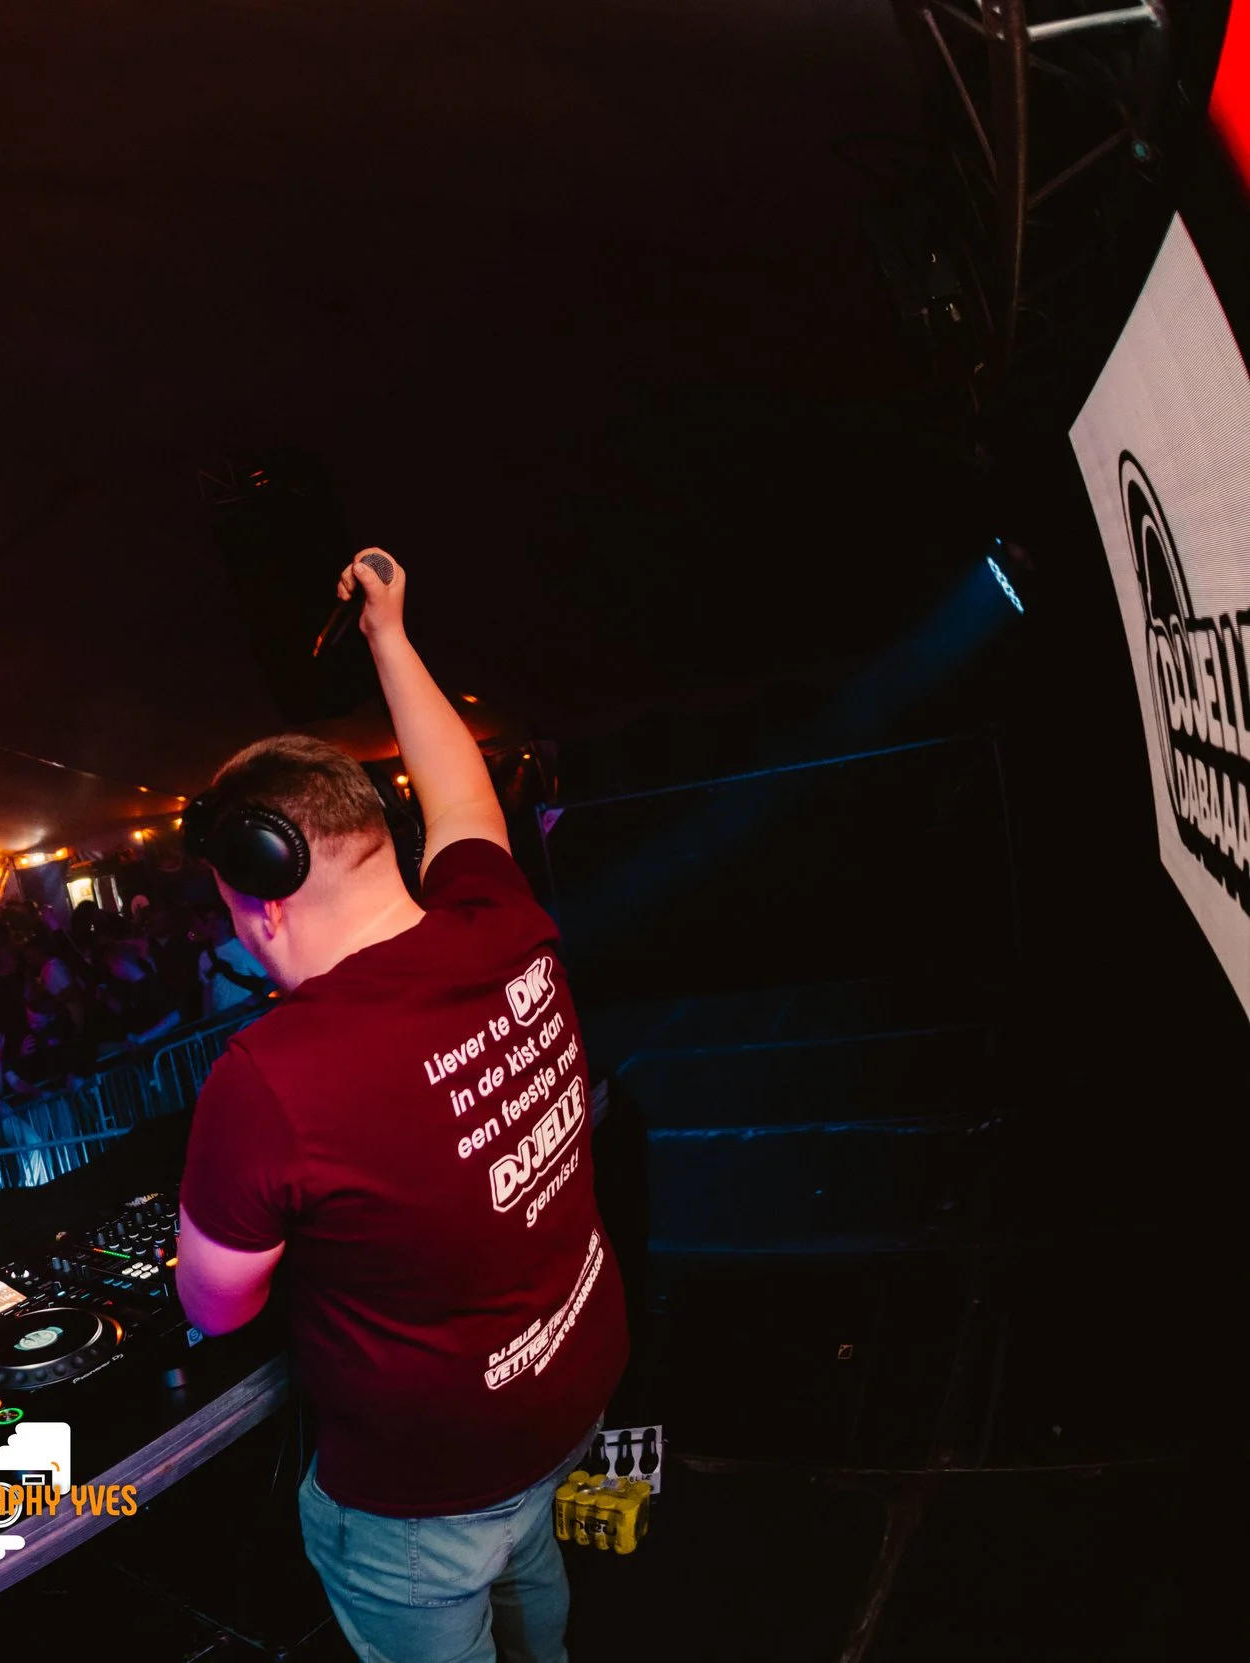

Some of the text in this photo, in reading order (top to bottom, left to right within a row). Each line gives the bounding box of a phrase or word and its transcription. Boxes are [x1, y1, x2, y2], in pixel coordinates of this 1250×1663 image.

[423, 956, 551, 1086] Liever te DIK
[449, 1011, 565, 1118] in de kist dan
[457, 1033, 579, 1160] een feestje met
[525, 1147, 580, 1228] gemist!
[485, 1327, 550, 1387] VETTIGE
[488, 1347, 506, 1368] DJ
